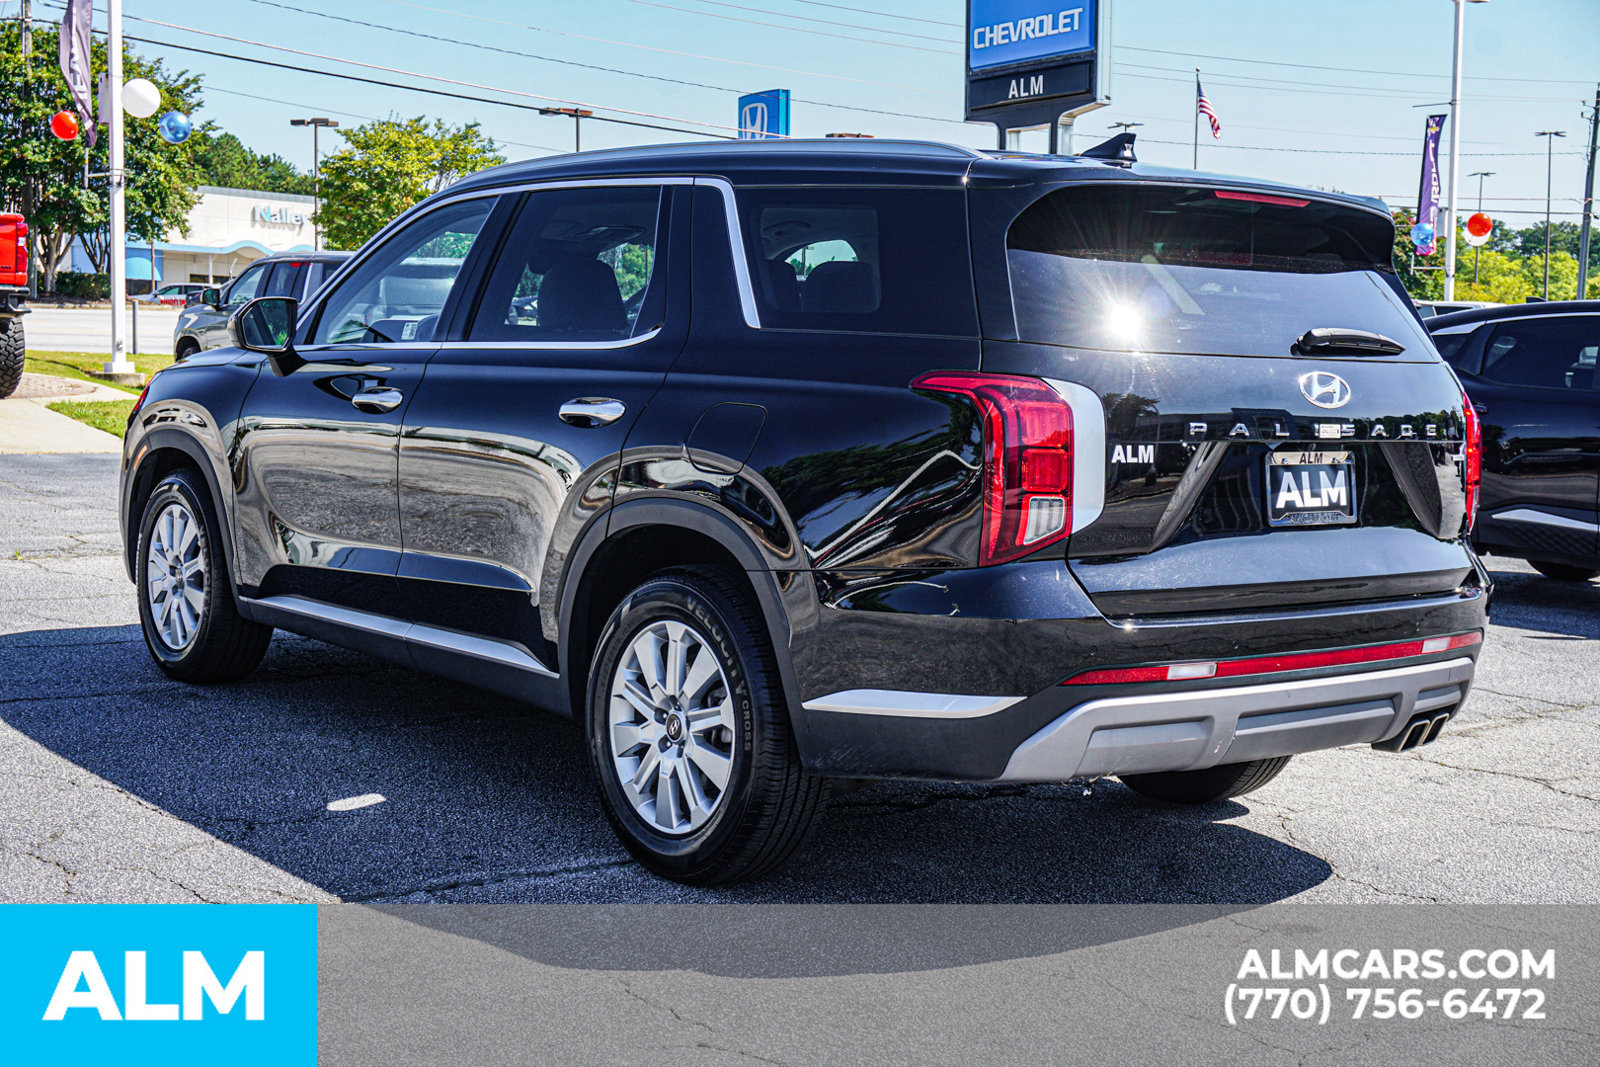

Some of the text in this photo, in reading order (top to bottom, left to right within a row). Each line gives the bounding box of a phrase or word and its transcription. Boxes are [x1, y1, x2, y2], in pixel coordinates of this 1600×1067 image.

[973, 7, 1083, 50] CHEVROLET
[1008, 74, 1044, 99] ALM
[252, 204, 312, 231] Nalley
[1111, 444, 1154, 464] ALM
[1298, 452, 1323, 464] ALM
[1275, 469, 1348, 509] ALM
[686, 594, 753, 752] VELOCITY CROSS
